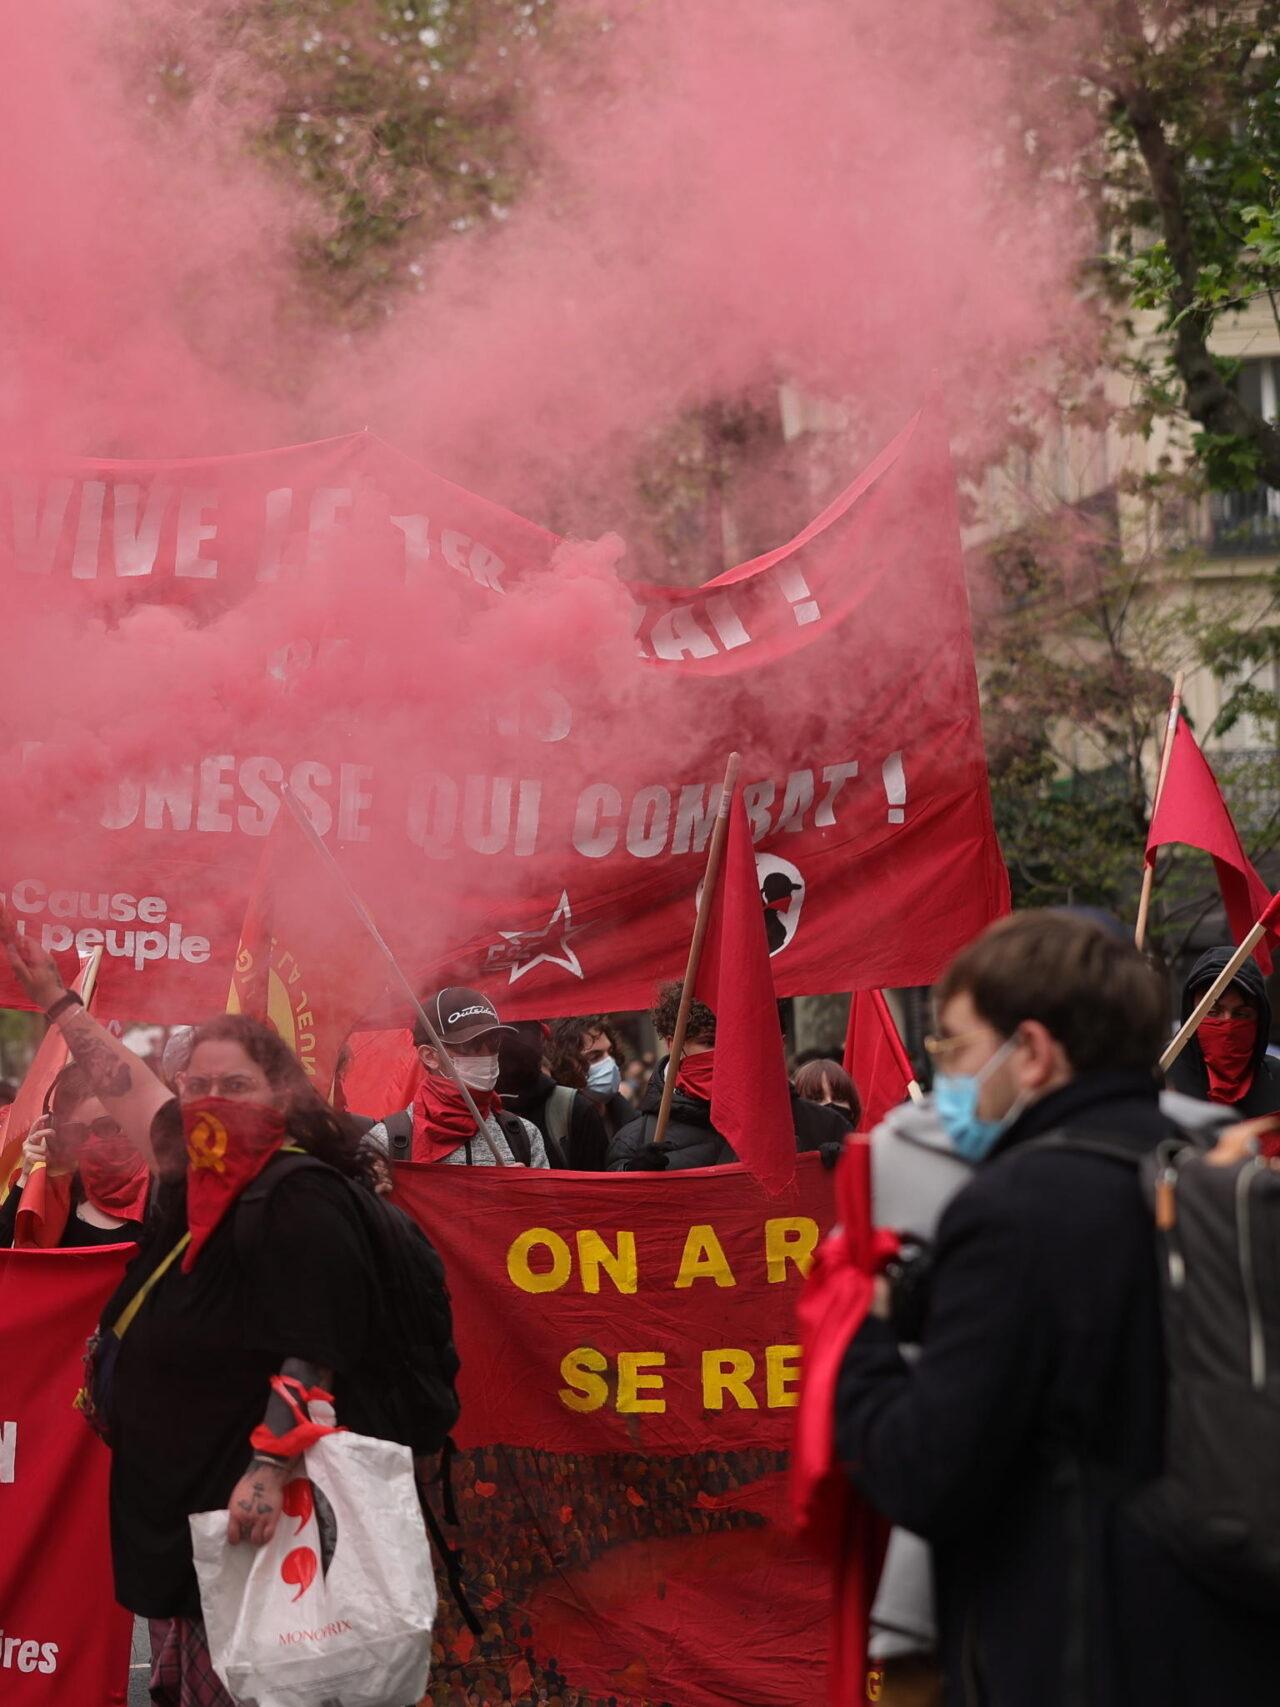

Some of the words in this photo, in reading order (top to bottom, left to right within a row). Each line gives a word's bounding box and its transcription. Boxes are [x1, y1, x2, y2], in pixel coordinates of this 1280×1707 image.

[10, 477, 218, 580] VIVE
[634, 599, 752, 660] AI
[771, 566, 821, 626] !
[406, 771, 542, 859] QUI
[572, 760, 859, 858] COMBAT
[881, 750, 908, 825] !
[11, 878, 168, 924] Cause
[41, 922, 211, 971] peuple
[506, 1226, 638, 1294] ON
[673, 1224, 736, 1288] A
[559, 1346, 666, 1413] SE
